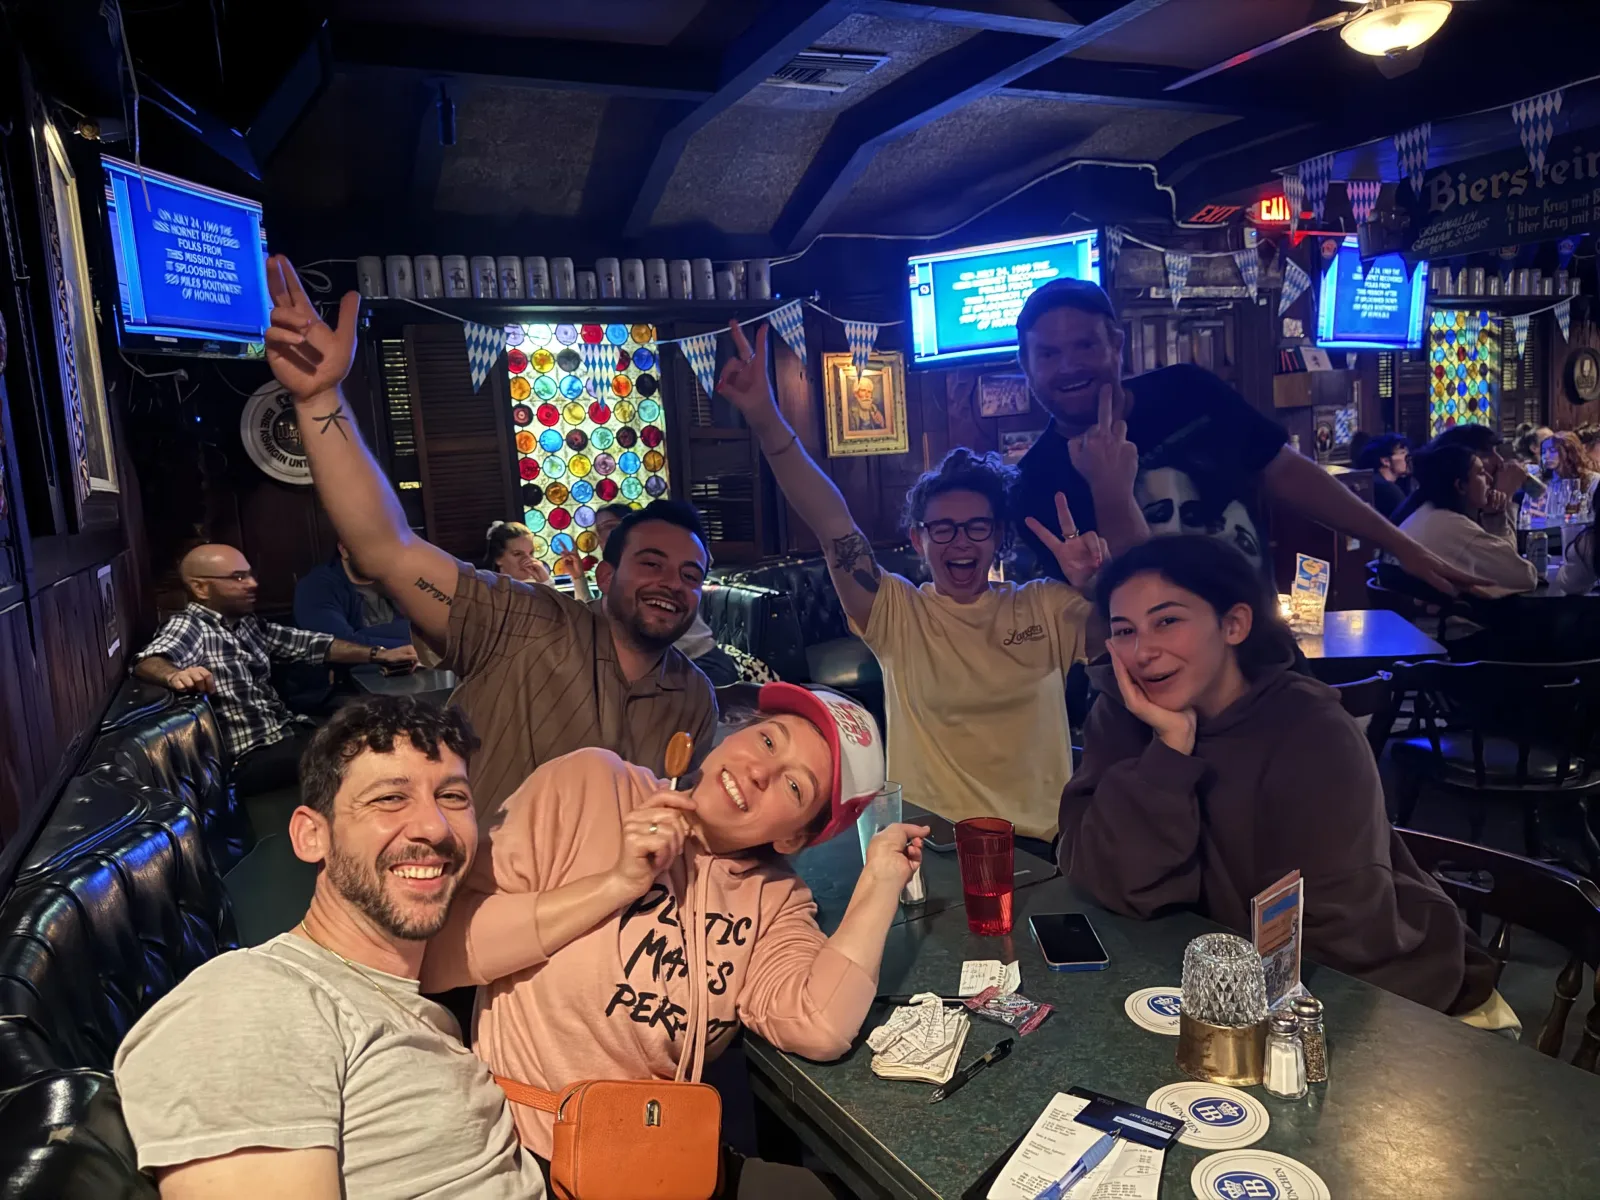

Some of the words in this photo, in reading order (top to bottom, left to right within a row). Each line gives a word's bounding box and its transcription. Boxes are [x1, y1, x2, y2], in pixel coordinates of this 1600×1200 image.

[173, 212, 189, 226] JULY
[1518, 220, 1540, 235] liter
[1543, 214, 1568, 231] Krug
[1572, 210, 1590, 225] mit
[170, 224, 199, 240] HORNET
[178, 238, 201, 252] FOLKS
[203, 243, 222, 256] FROM
[185, 252, 213, 266] MISSION
[175, 262, 217, 279] SPLOOSHED
[181, 275, 201, 289] MILES
[194, 289, 231, 305] HONOLULU
[620, 884, 752, 946] PLTIC
[624, 928, 734, 995] MAS
[1167, 1101, 1201, 1134] MÜNCHEN
[1195, 1105, 1224, 1122] HB
[1242, 1179, 1272, 1198] HB
